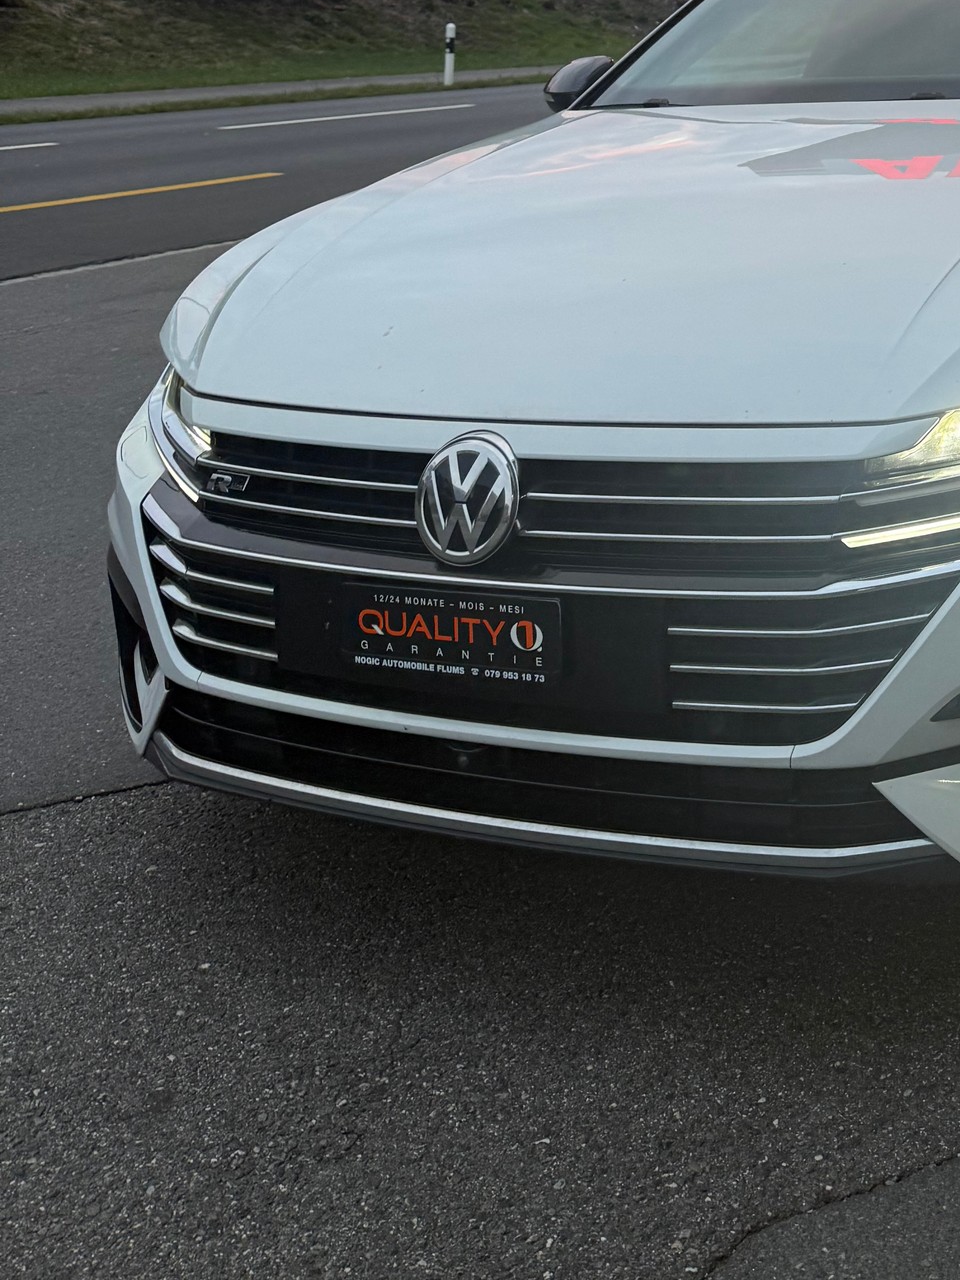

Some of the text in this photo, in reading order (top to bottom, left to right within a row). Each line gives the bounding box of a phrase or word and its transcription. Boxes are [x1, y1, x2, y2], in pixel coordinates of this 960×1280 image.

[373, 594, 400, 604] 12/24
[405, 596, 445, 608] MONATE
[459, 601, 485, 611] MOIS
[499, 604, 524, 614] MESI
[358, 609, 506, 647] QUALITY
[360, 640, 543, 667] GARANTIE
[355, 656, 380, 666] NOGIC
[382, 659, 435, 672] AUTOMOBILE
[437, 664, 465, 675] FLUMS
[484, 669, 501, 678] 079
[502, 671, 519, 680] 953
[534, 674, 545, 683] 73
